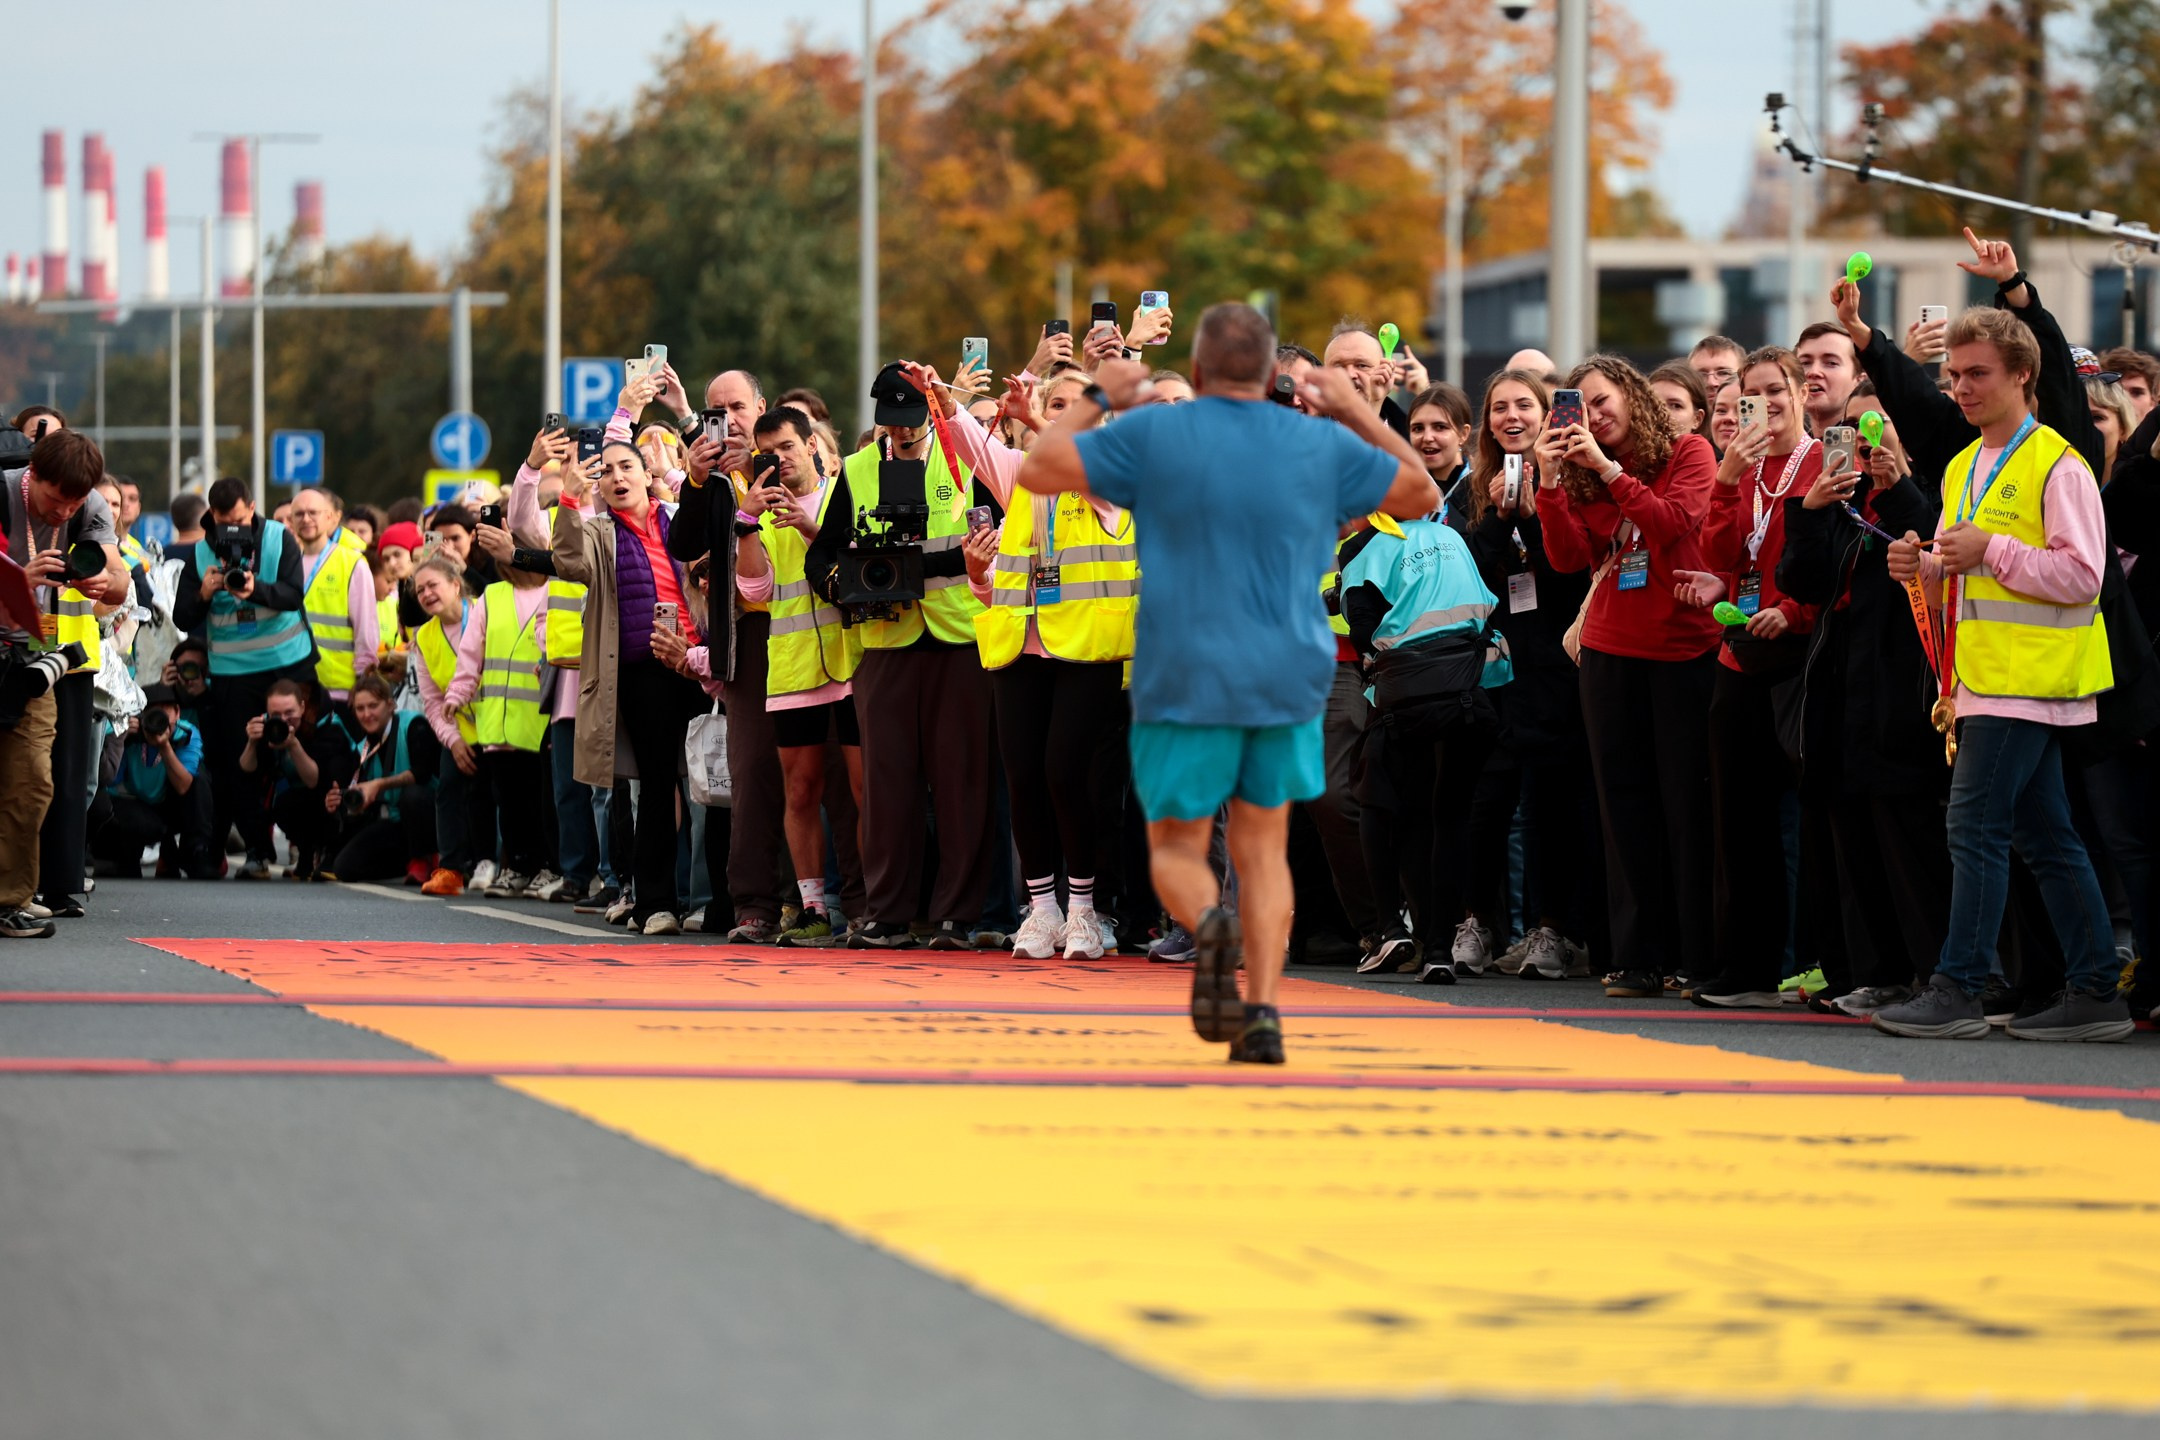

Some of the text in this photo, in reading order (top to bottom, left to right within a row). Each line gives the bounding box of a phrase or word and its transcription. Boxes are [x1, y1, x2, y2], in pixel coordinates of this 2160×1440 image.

[574, 362, 614, 421] P
[285, 435, 315, 481] P
[1910, 589, 1926, 623] 42.195
